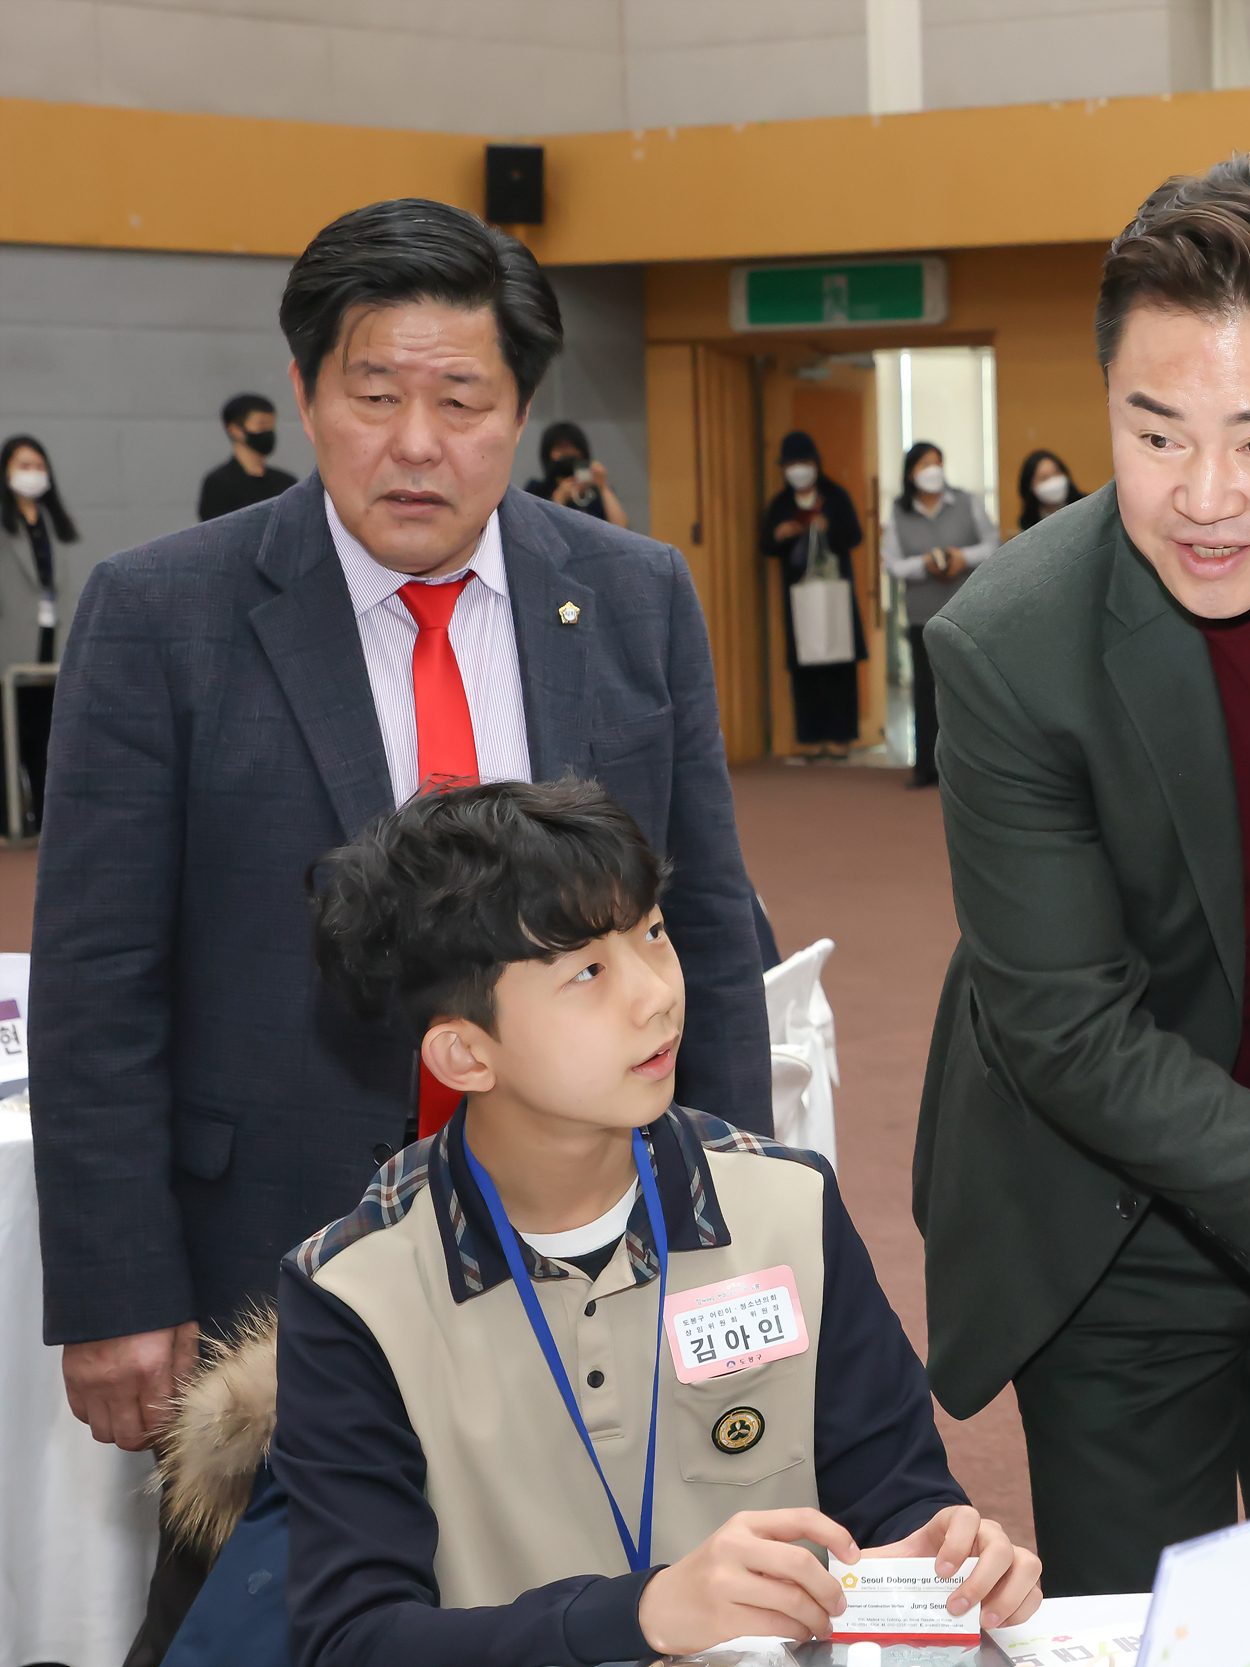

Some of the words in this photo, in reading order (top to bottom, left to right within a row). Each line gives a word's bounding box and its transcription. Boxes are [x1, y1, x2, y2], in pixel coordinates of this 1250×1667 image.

[682, 1315, 705, 1327] 도봉구
[709, 1306, 732, 1319] 어린이
[739, 1293, 778, 1311] 청소년의회
[690, 1314, 785, 1364] 김아인
[739, 1354, 763, 1365] 도봉구
[861, 1576, 884, 1584] Seoul
[886, 1576, 931, 1585] Dobong-gu
[934, 1576, 964, 1584] Council
